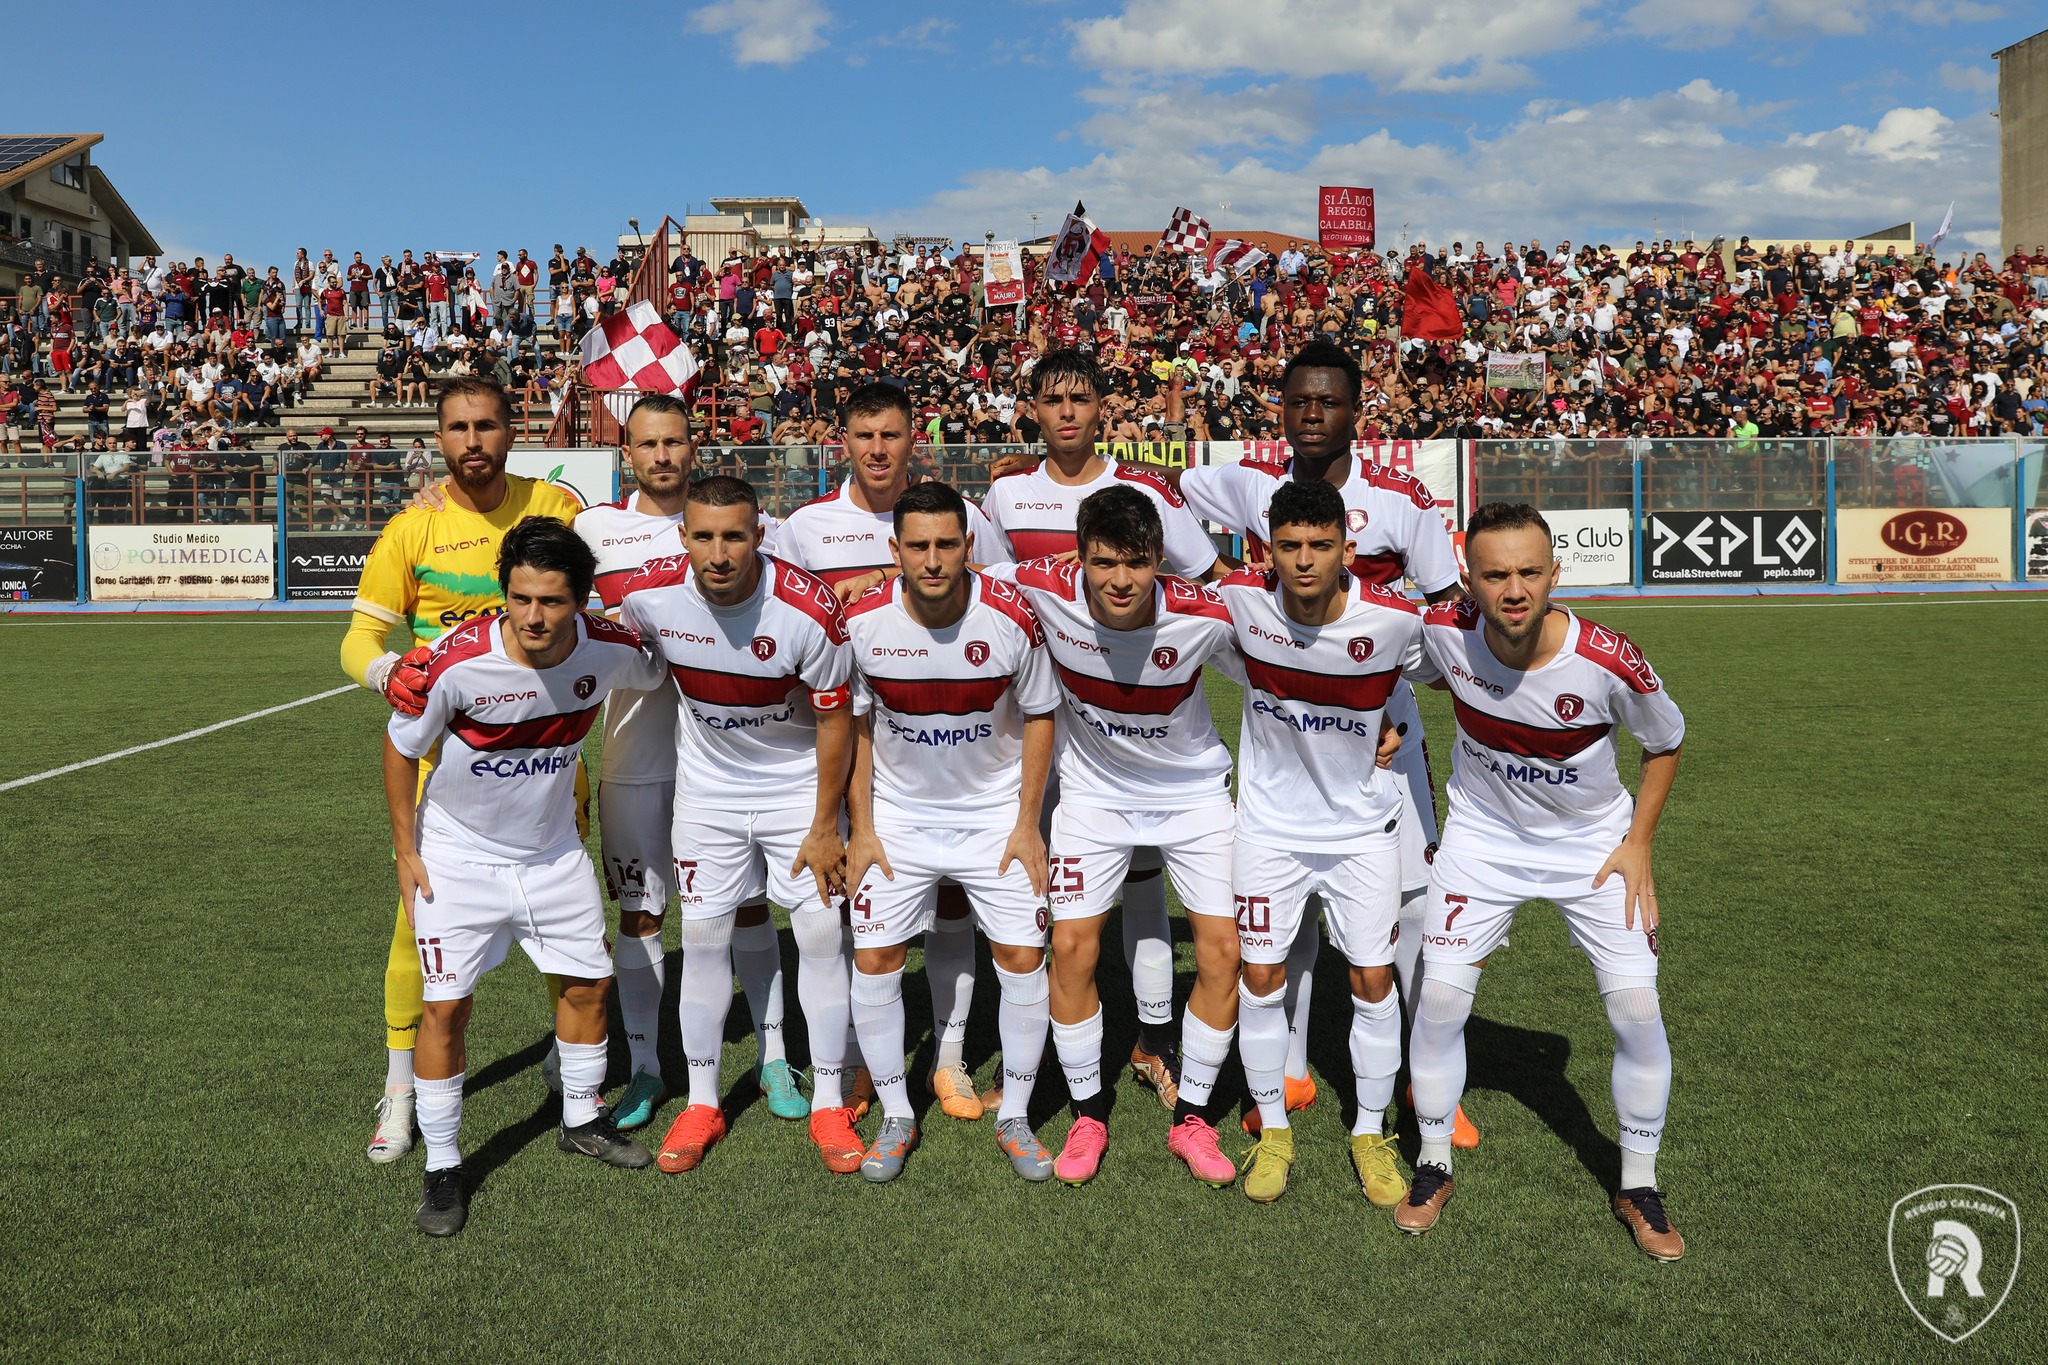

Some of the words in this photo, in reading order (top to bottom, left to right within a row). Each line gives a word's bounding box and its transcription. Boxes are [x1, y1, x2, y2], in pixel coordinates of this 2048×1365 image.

[1327, 206, 1367, 216] REGGIO
[1320, 220, 1373, 230] CALABRIA
[994, 292, 1016, 300] MAURO
[824, 318, 836, 328] 93
[1014, 502, 1062, 511] GIVOVA
[153, 534, 183, 544] Studio
[186, 534, 220, 544] Medico
[434, 536, 490, 554] GIVOVA
[602, 534, 652, 547] GIVOVA
[822, 533, 874, 544] GIVOVA
[1576, 527, 1623, 548] Club
[1653, 515, 1817, 566] PEPLO
[128, 548, 269, 564] POLIMEDICA
[1572, 552, 1614, 562] Pizzeria
[1947, 556, 1998, 564] LATTONERIA
[1652, 568, 1742, 578] Casual&Streetwear
[1764, 567, 1816, 578] peplo.shop
[1872, 564, 1976, 572] IPERMEABILIZZAZIONI
[2, 581, 27, 590] IONICA
[95, 576, 117, 585] Corso
[158, 576, 171, 584] 277
[220, 576, 240, 584] 0964
[660, 628, 716, 646] GIVOVA
[1056, 630, 1110, 654] GIVOVA
[1249, 625, 1304, 650] GIVOVA
[872, 648, 928, 658] GIVOVA
[1452, 666, 1504, 694] GIVOVA
[475, 690, 538, 706] GIVOVA
[813, 692, 839, 709] C
[612, 857, 644, 887] 14
[673, 857, 698, 893] 17
[1050, 858, 1084, 892] 25
[854, 884, 873, 920] 4
[1234, 894, 1270, 932] 20
[1444, 893, 1468, 932] 7
[418, 938, 440, 974] 11
